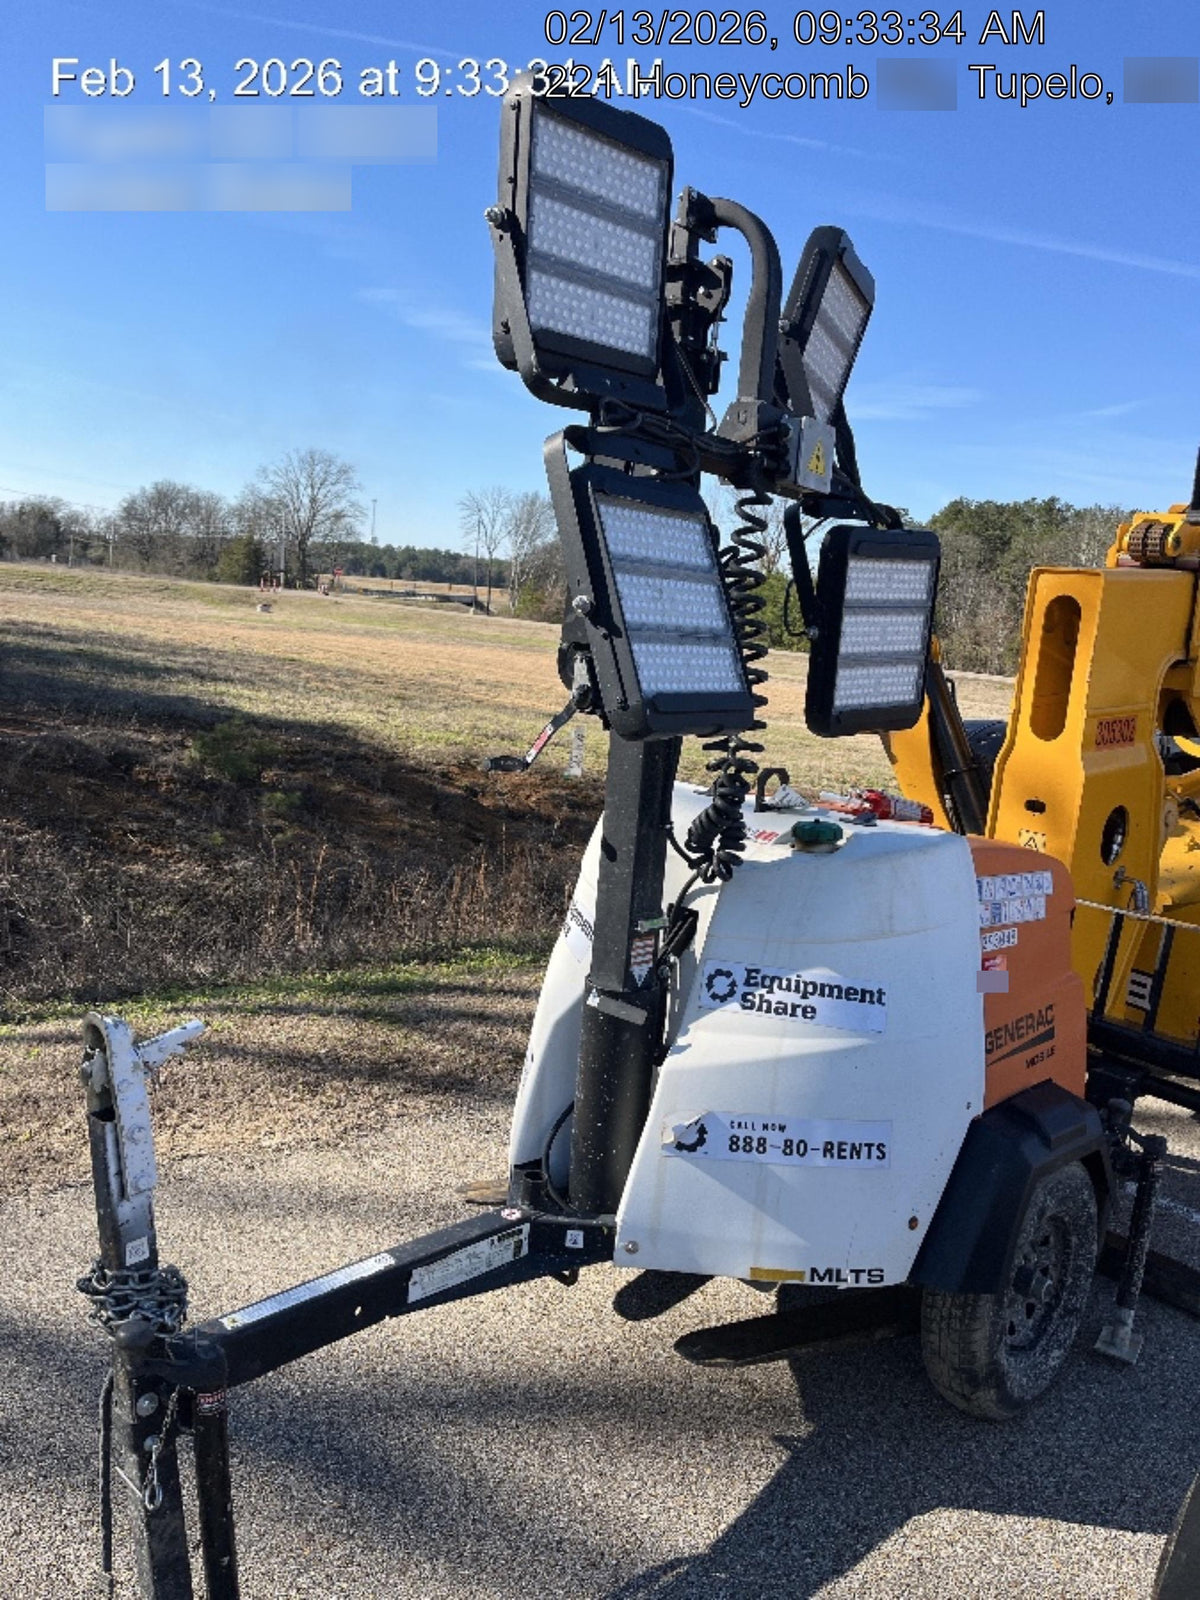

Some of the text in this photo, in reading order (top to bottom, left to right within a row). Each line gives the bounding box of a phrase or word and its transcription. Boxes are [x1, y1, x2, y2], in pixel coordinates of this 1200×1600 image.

[742, 967, 887, 1007] Equipment
[740, 991, 817, 1021] Share
[984, 1003, 1056, 1055] GENERAC
[729, 1120, 787, 1133] CALL NOW
[728, 1134, 887, 1161] 888-80-RENTS
[809, 1266, 886, 1285] MLTS
